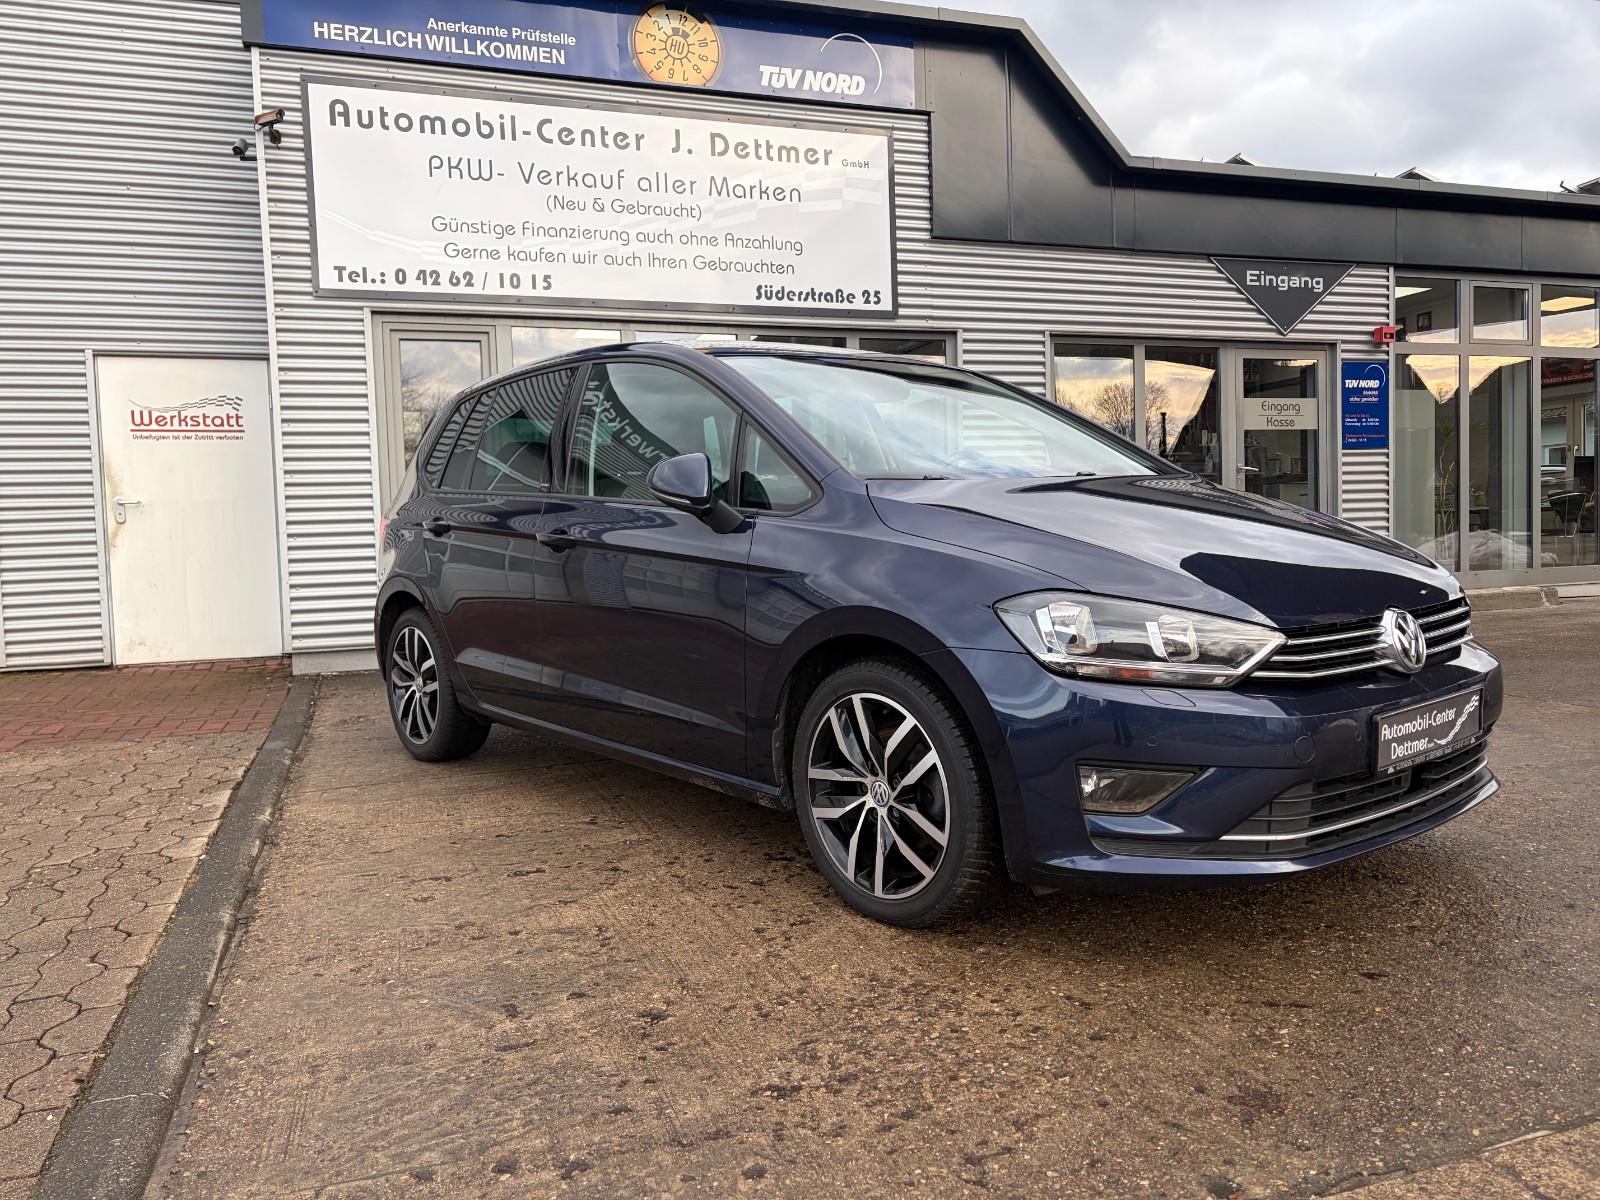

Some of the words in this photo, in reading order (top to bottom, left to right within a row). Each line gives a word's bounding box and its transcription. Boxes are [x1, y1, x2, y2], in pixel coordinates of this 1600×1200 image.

[313, 21, 422, 50] HERZLICH
[425, 33, 566, 65] WILLKOMMEN
[427, 17, 508, 38] Anerkannte
[512, 27, 577, 46] Prüfstelle
[669, 39, 685, 55] HU
[760, 65, 803, 89] TÜV
[803, 70, 866, 95] NORD
[328, 98, 645, 152] Automobil-Center
[671, 128, 694, 156] J.
[709, 131, 833, 167] Dettmer
[841, 158, 870, 169] GmbH
[428, 154, 505, 182] PKW-
[516, 160, 625, 191] Verkauf
[636, 171, 697, 196] aller
[708, 175, 802, 204] Marken
[546, 193, 587, 214] (Neu
[591, 197, 606, 213] &
[610, 198, 702, 222] Gebraucht)
[431, 215, 517, 240] Günstige
[521, 220, 630, 247] Finanzierung
[635, 227, 674, 245] auch
[678, 230, 720, 248] ohne
[724, 232, 804, 257] Anzahlung
[443, 241, 502, 261] Gerne
[507, 244, 567, 264] kaufen
[572, 250, 599, 265] wir
[603, 250, 643, 268] auch
[647, 252, 688, 270] Ihren
[692, 254, 795, 276] Gebrauchten
[332, 265, 387, 285] Tel.:
[394, 267, 408, 286] 0
[414, 268, 442, 287] 42
[448, 270, 475, 288] 62
[481, 271, 489, 292] /
[498, 272, 522, 290] 10
[531, 273, 553, 291] 15
[1247, 270, 1323, 293] Eingang
[755, 283, 857, 305] Süderstraße
[861, 289, 882, 306] 25
[1359, 380, 1380, 388] NORD
[130, 409, 244, 428] Werkstatt
[1261, 400, 1301, 415] Eingang
[1266, 416, 1296, 427] Kasse
[1381, 708, 1457, 742] Automobil-Center
[1391, 737, 1429, 760] Dettmer
